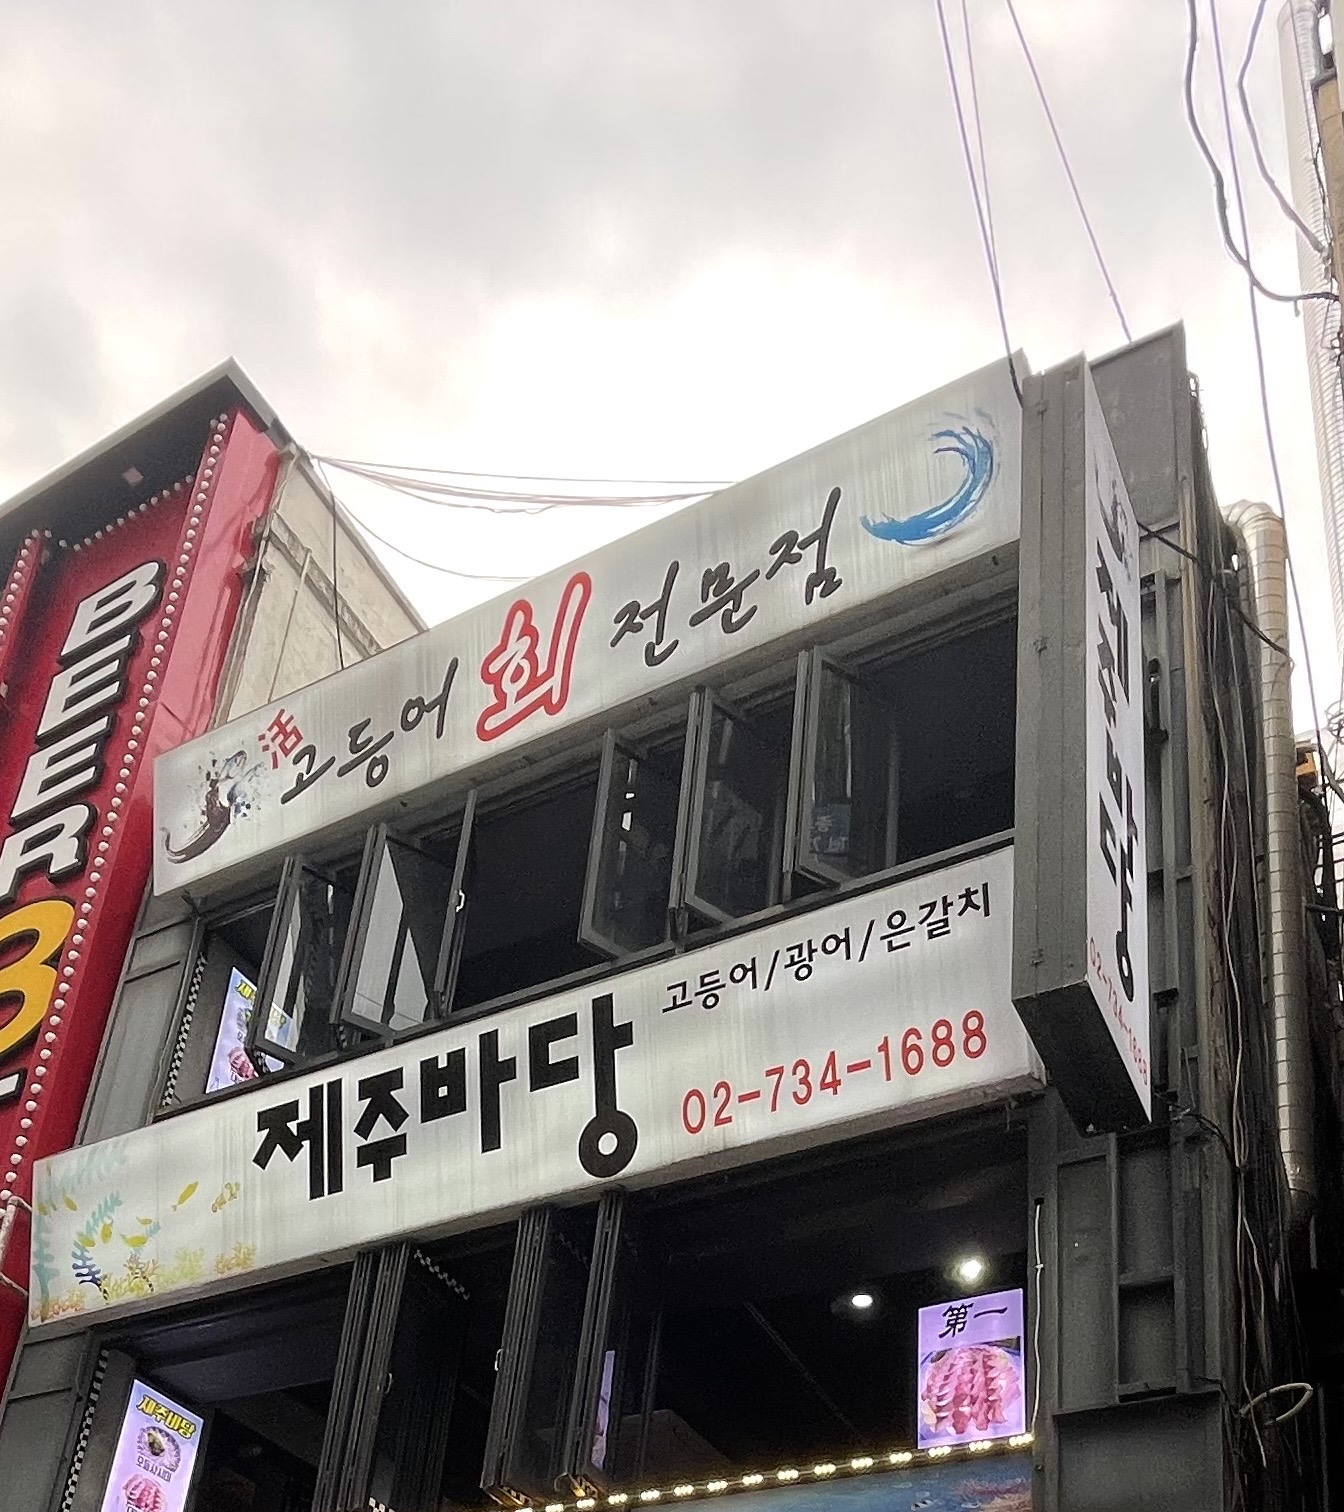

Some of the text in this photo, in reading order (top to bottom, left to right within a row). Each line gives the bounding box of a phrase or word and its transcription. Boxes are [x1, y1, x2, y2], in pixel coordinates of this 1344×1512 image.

[477, 571, 593, 741] 회
[610, 487, 843, 667] 전문점
[254, 994, 639, 1200] 제주바당
[681, 1010, 988, 1136] 02-734-1688
[939, 1303, 1008, 1338] 第一
[136, 1394, 196, 1440] 제주바당
